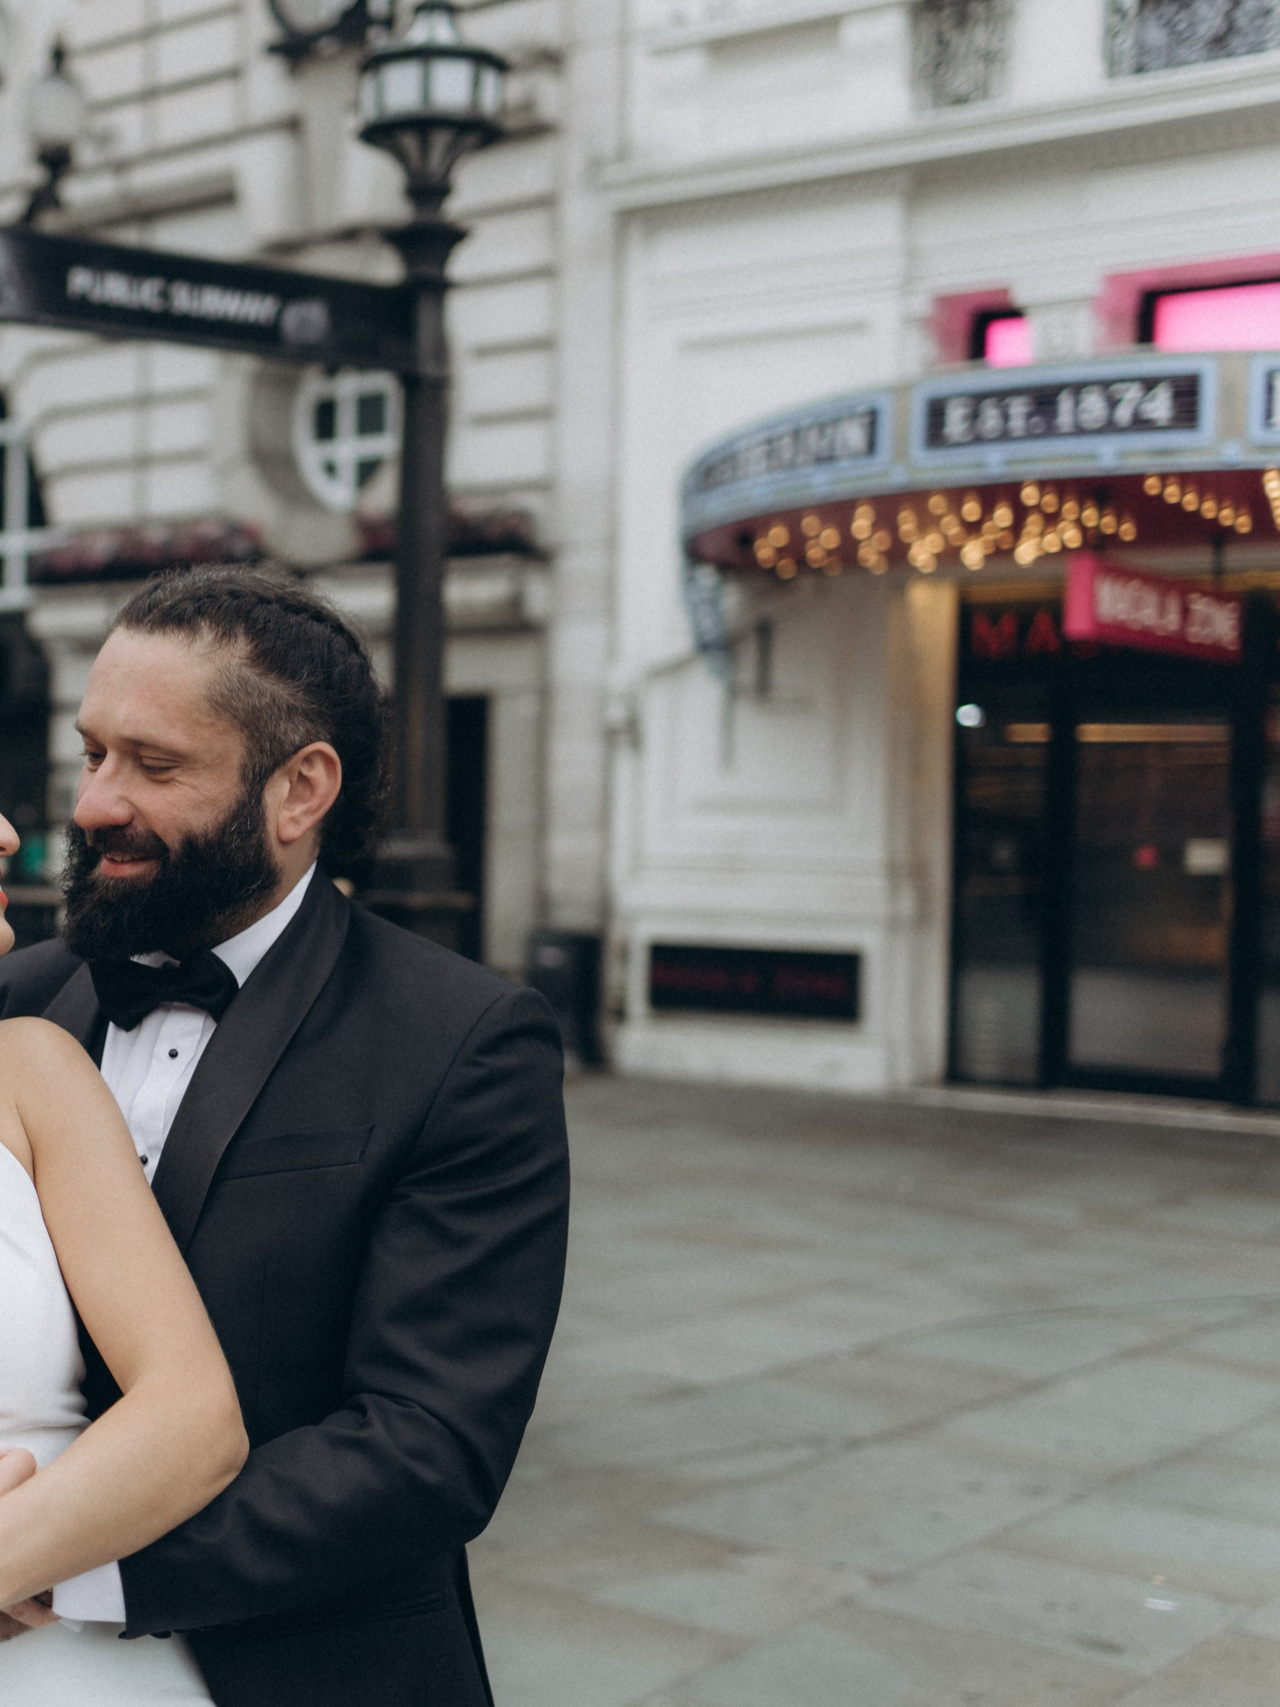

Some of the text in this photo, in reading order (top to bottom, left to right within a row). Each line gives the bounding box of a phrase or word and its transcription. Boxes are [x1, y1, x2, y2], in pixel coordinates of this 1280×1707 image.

[67, 265, 281, 327] PUBLIC SUBWAY
[1056, 380, 1174, 434] 1874
